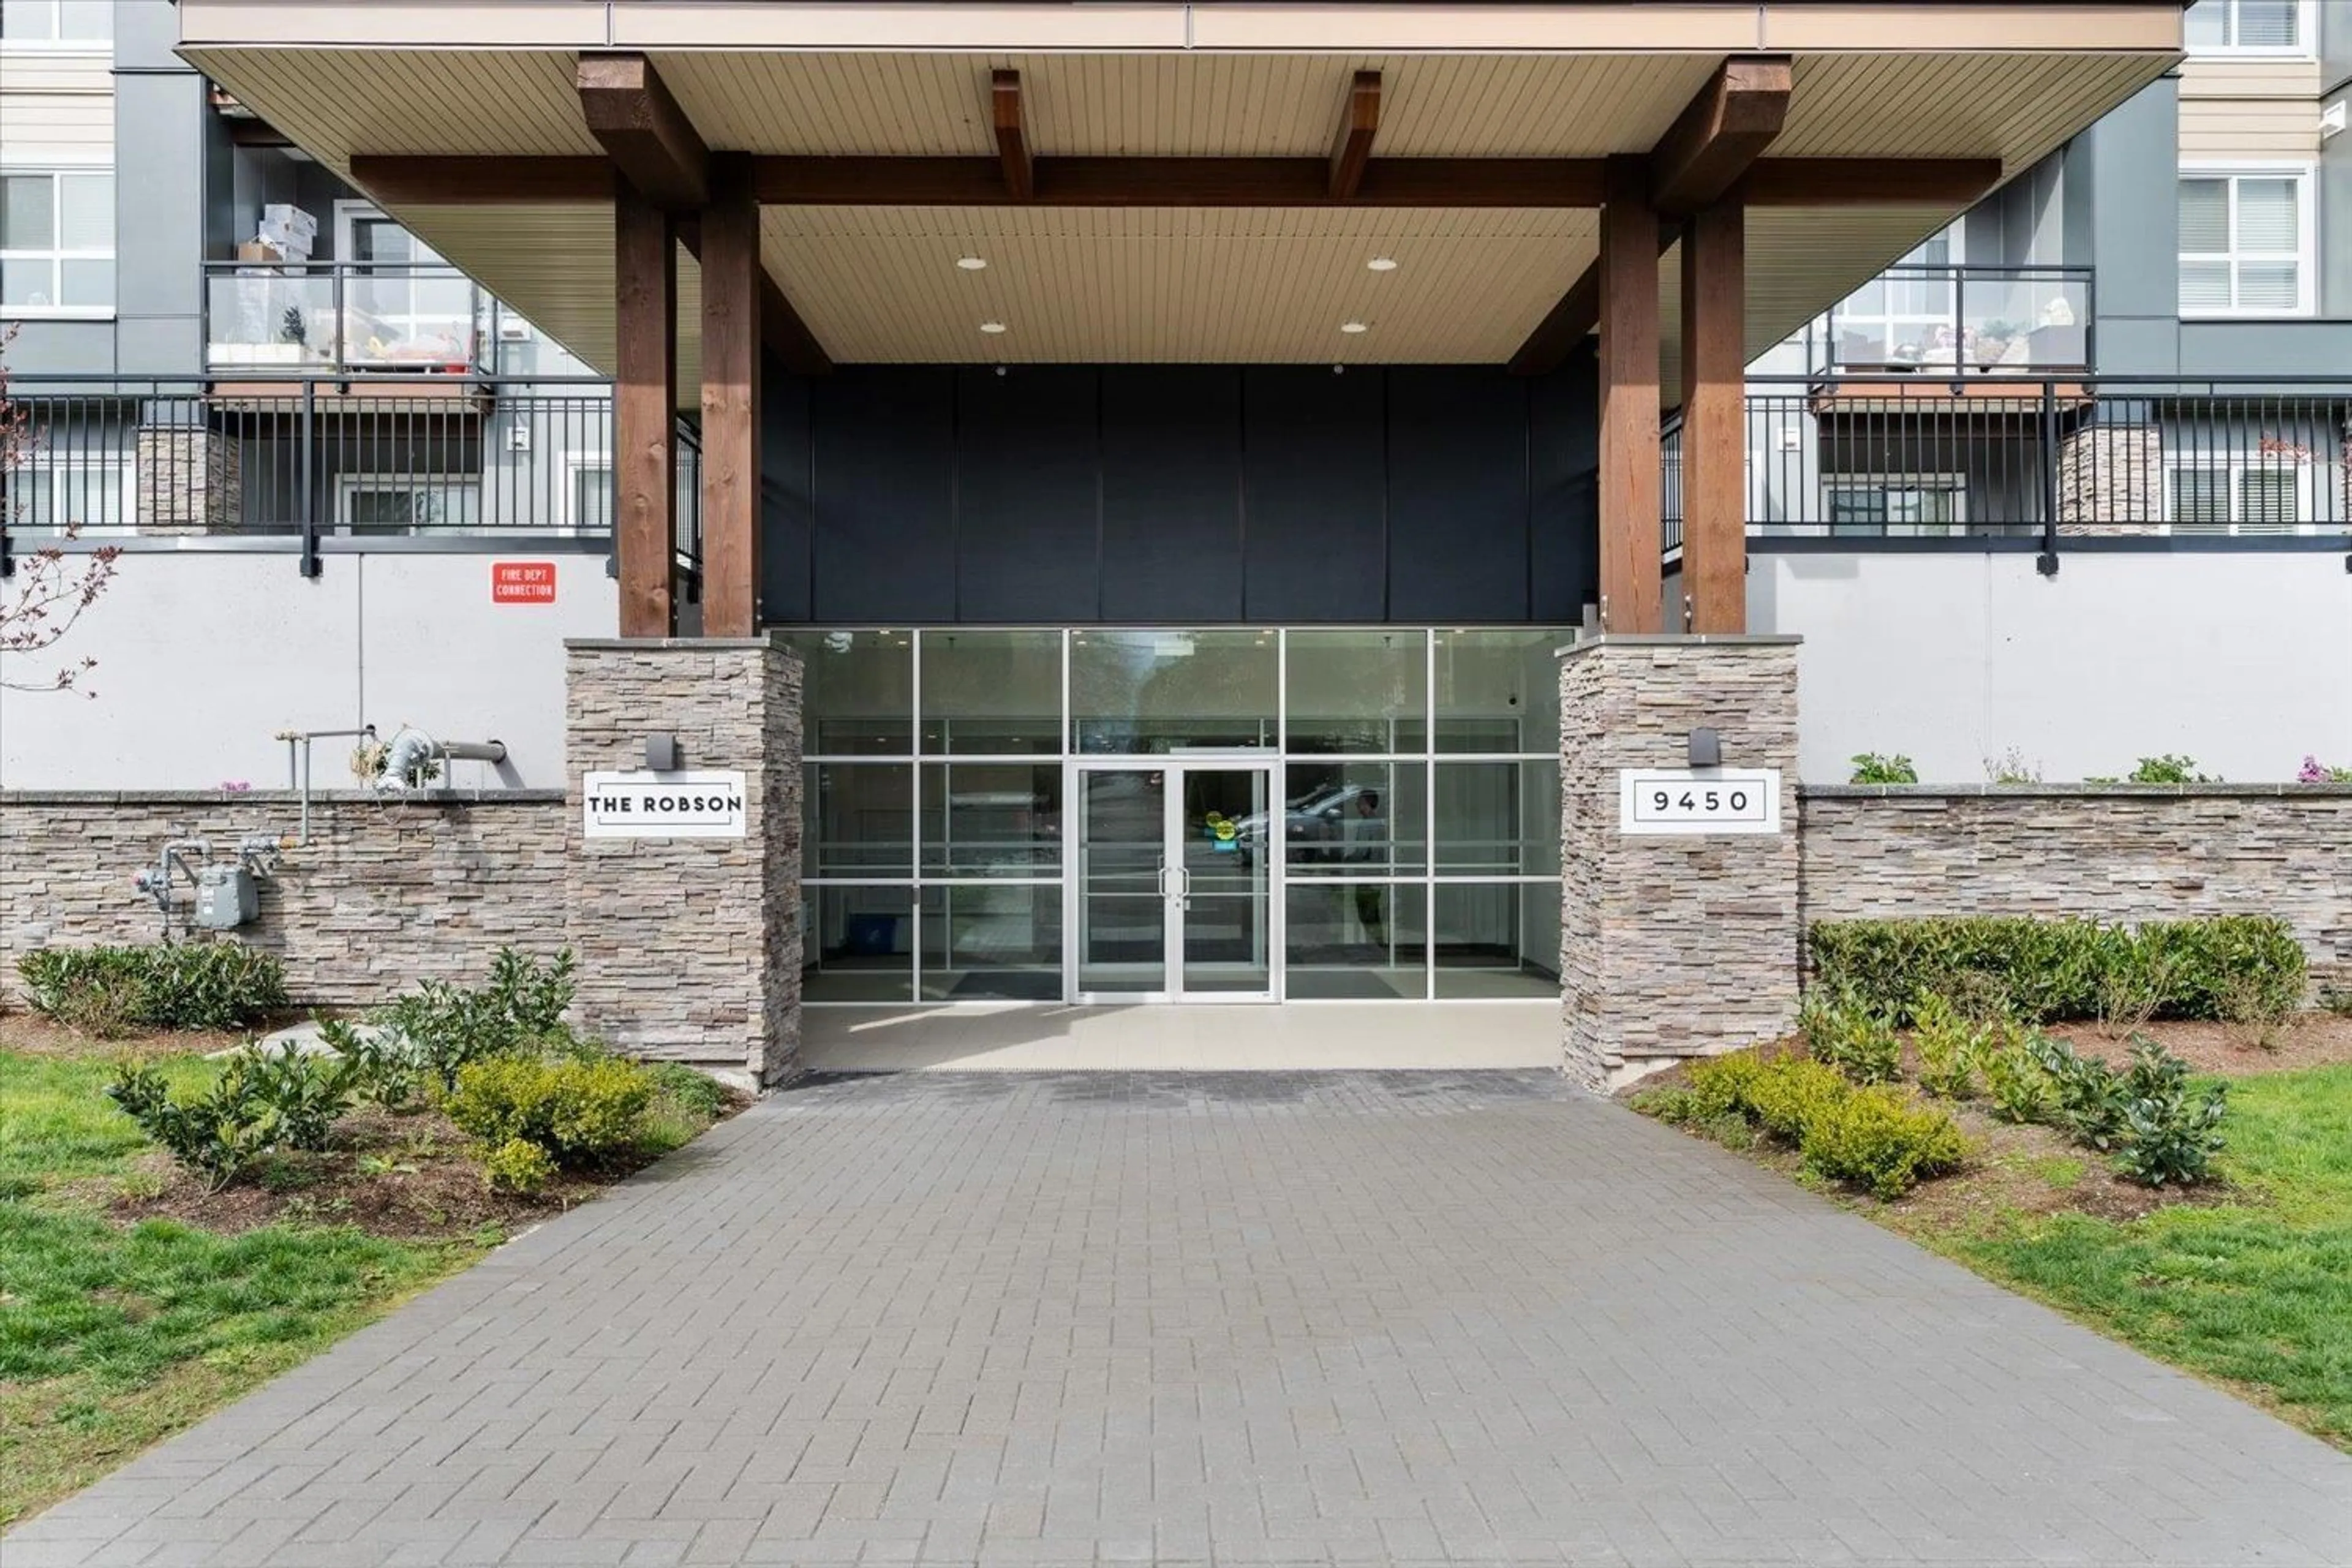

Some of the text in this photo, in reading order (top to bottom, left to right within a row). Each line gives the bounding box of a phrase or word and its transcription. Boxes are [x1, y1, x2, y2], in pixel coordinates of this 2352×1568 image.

[501, 569, 547, 581] FIRE DEPT
[496, 584, 552, 595] CONNECTION
[589, 796, 741, 812] THE ROBSON
[1654, 791, 1747, 811] 9450
